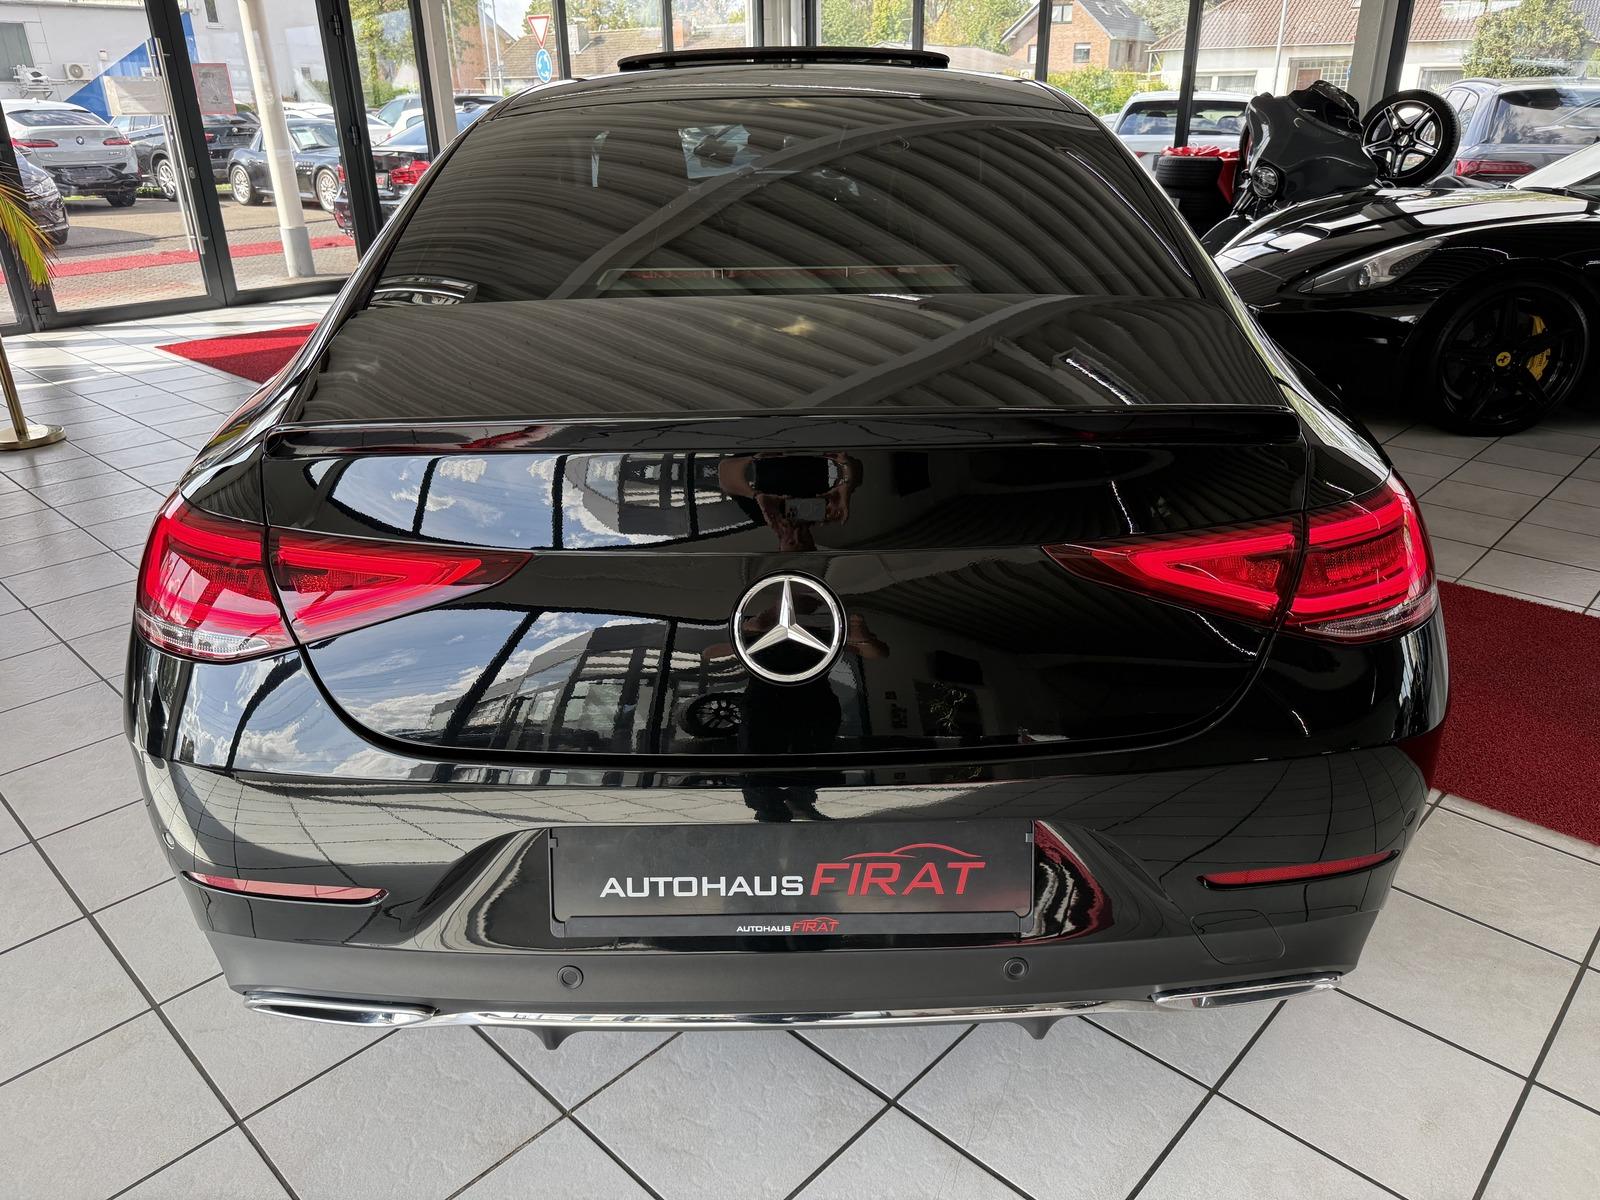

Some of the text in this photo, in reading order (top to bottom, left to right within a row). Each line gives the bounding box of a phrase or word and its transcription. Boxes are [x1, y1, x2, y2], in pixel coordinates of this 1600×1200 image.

[600, 862, 985, 898] AUTOHAUS FIRAT
[736, 922, 840, 933] AUTOHAUS FIRAT
